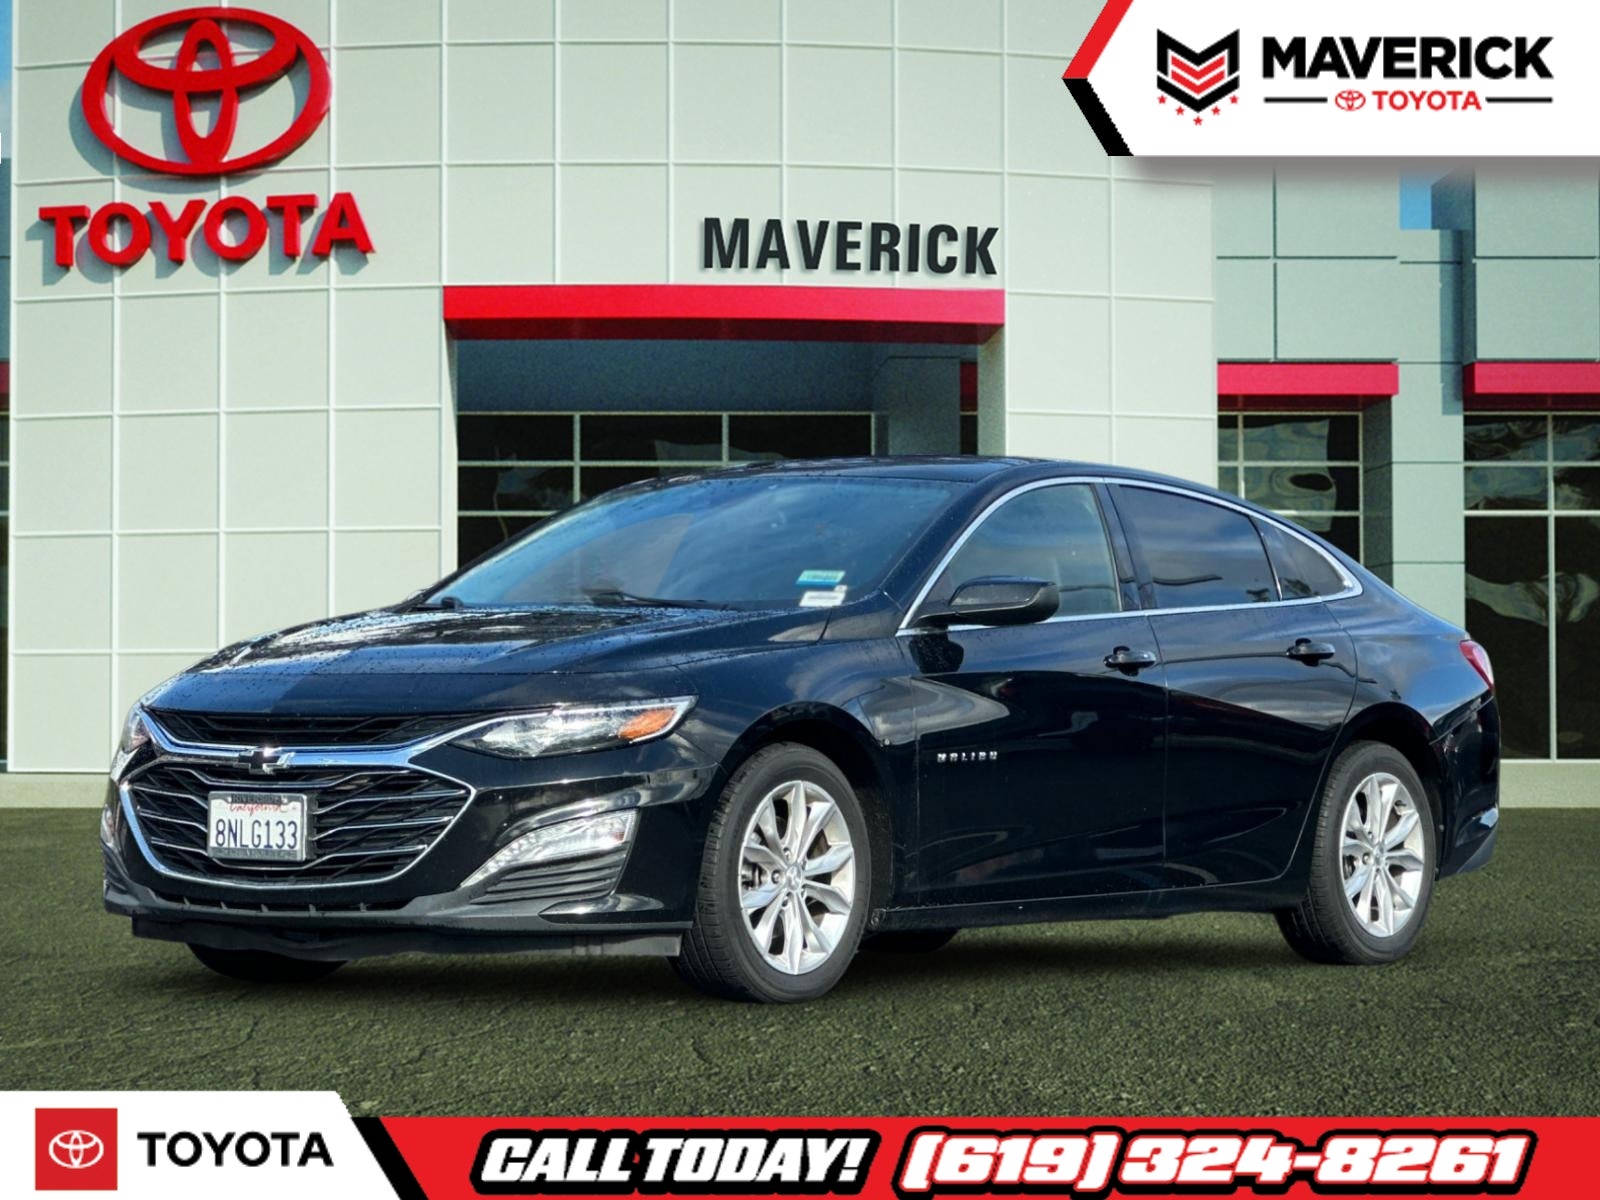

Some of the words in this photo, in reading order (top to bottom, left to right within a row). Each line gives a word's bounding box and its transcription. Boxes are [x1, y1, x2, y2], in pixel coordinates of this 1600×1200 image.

[39, 192, 376, 267] TOYOTA
[703, 217, 999, 275] MAVERICK
[937, 751, 998, 762] MALIBU
[216, 819, 298, 849] 8NLG133
